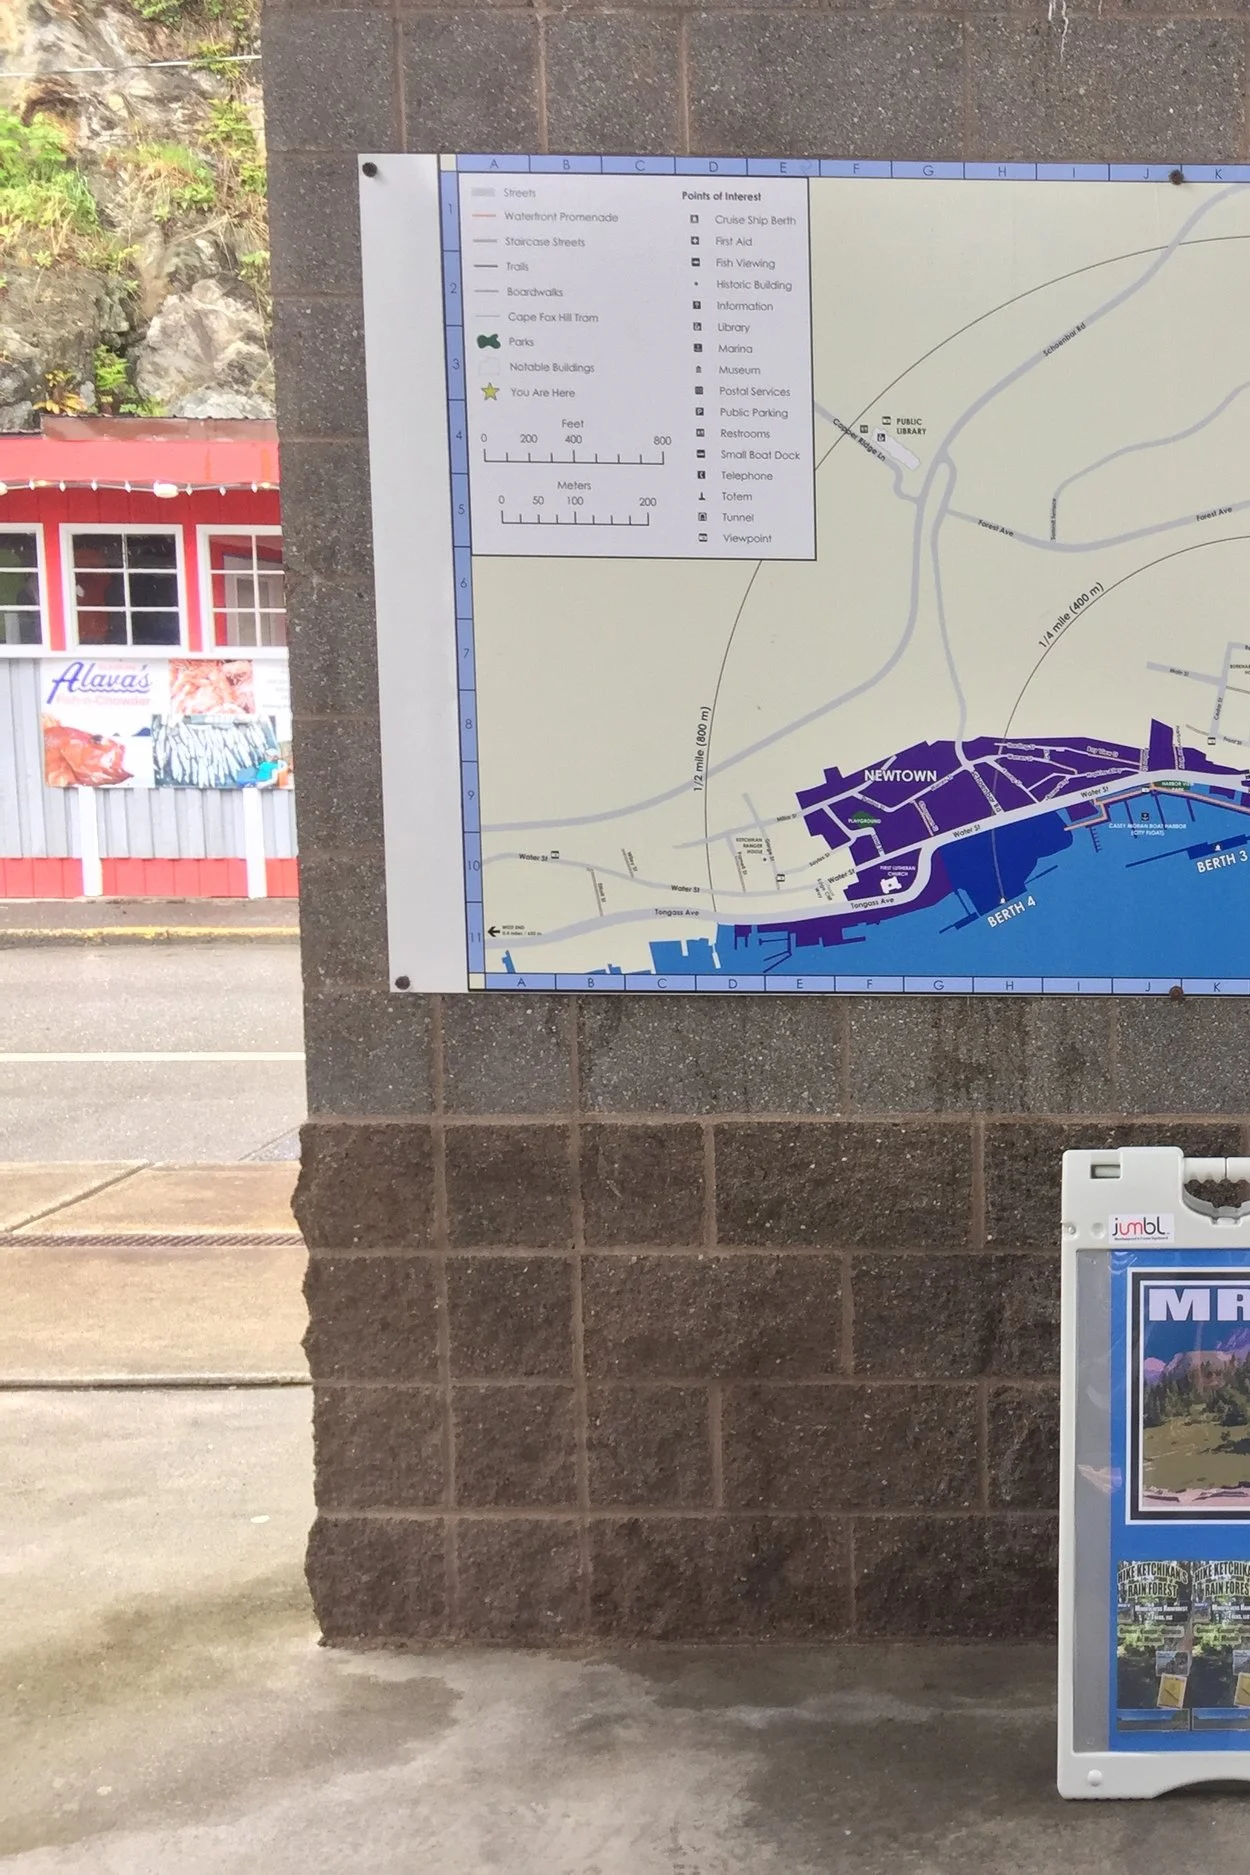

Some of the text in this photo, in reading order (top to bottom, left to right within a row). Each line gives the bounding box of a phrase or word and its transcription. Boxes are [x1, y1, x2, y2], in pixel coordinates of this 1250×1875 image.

[504, 188, 536, 198] Streets
[682, 192, 761, 201] Points of Interest
[504, 212, 618, 222] Waterfront Promenade
[715, 215, 796, 226] Cruise Ship Berth
[505, 237, 585, 247] Staircase Streets
[716, 236, 752, 246] First Aid
[506, 262, 529, 271] Trails
[716, 258, 775, 270] Fish Viewing
[717, 280, 792, 292] Historic Building
[507, 287, 563, 296] Boardwalks
[717, 301, 773, 311] Information
[508, 312, 598, 323] Cape Fox Hill Tram
[718, 323, 750, 333] Library
[509, 337, 534, 346] Parks
[718, 344, 752, 353] Marina
[510, 363, 594, 374] Notable Buildings
[719, 366, 760, 374] Museum
[510, 388, 575, 398] You Are Here
[720, 386, 790, 396] Postal Services
[720, 408, 788, 419] Public Parking
[562, 419, 584, 428] Feet
[721, 429, 770, 438] Restrooms
[481, 433, 672, 445] 0 200 400 800
[721, 450, 800, 460] Small Boat Dock
[722, 471, 773, 481] Telephone
[558, 481, 591, 490] Meters
[498, 495, 656, 506] 0 50 100 200
[722, 492, 752, 501] Totem
[722, 513, 754, 522] Tunnel
[1196, 507, 1232, 522] Forest Ave
[978, 520, 1014, 537] Forest Ave
[723, 534, 772, 544] Viewpoint
[1038, 582, 1104, 648] 1/4 mile (400 m)
[46, 660, 149, 704] Alava's
[694, 706, 712, 792] 1/2 mile (800 m)
[864, 770, 936, 782] NEWTOWN
[518, 853, 539, 862] Water
[1197, 850, 1248, 874] BERTH 3
[671, 884, 692, 894] Water
[850, 900, 878, 910] Tongass
[654, 909, 683, 918] Tongass
[987, 896, 1036, 928] BERTH 4
[1112, 1216, 1165, 1236] jumbl
[1118, 1564, 1136, 1582] HIKE
[1194, 1564, 1212, 1582] HIKE
[1128, 1582, 1178, 1597] RAIN FOREST
[1204, 1582, 1224, 1596] RAIN
